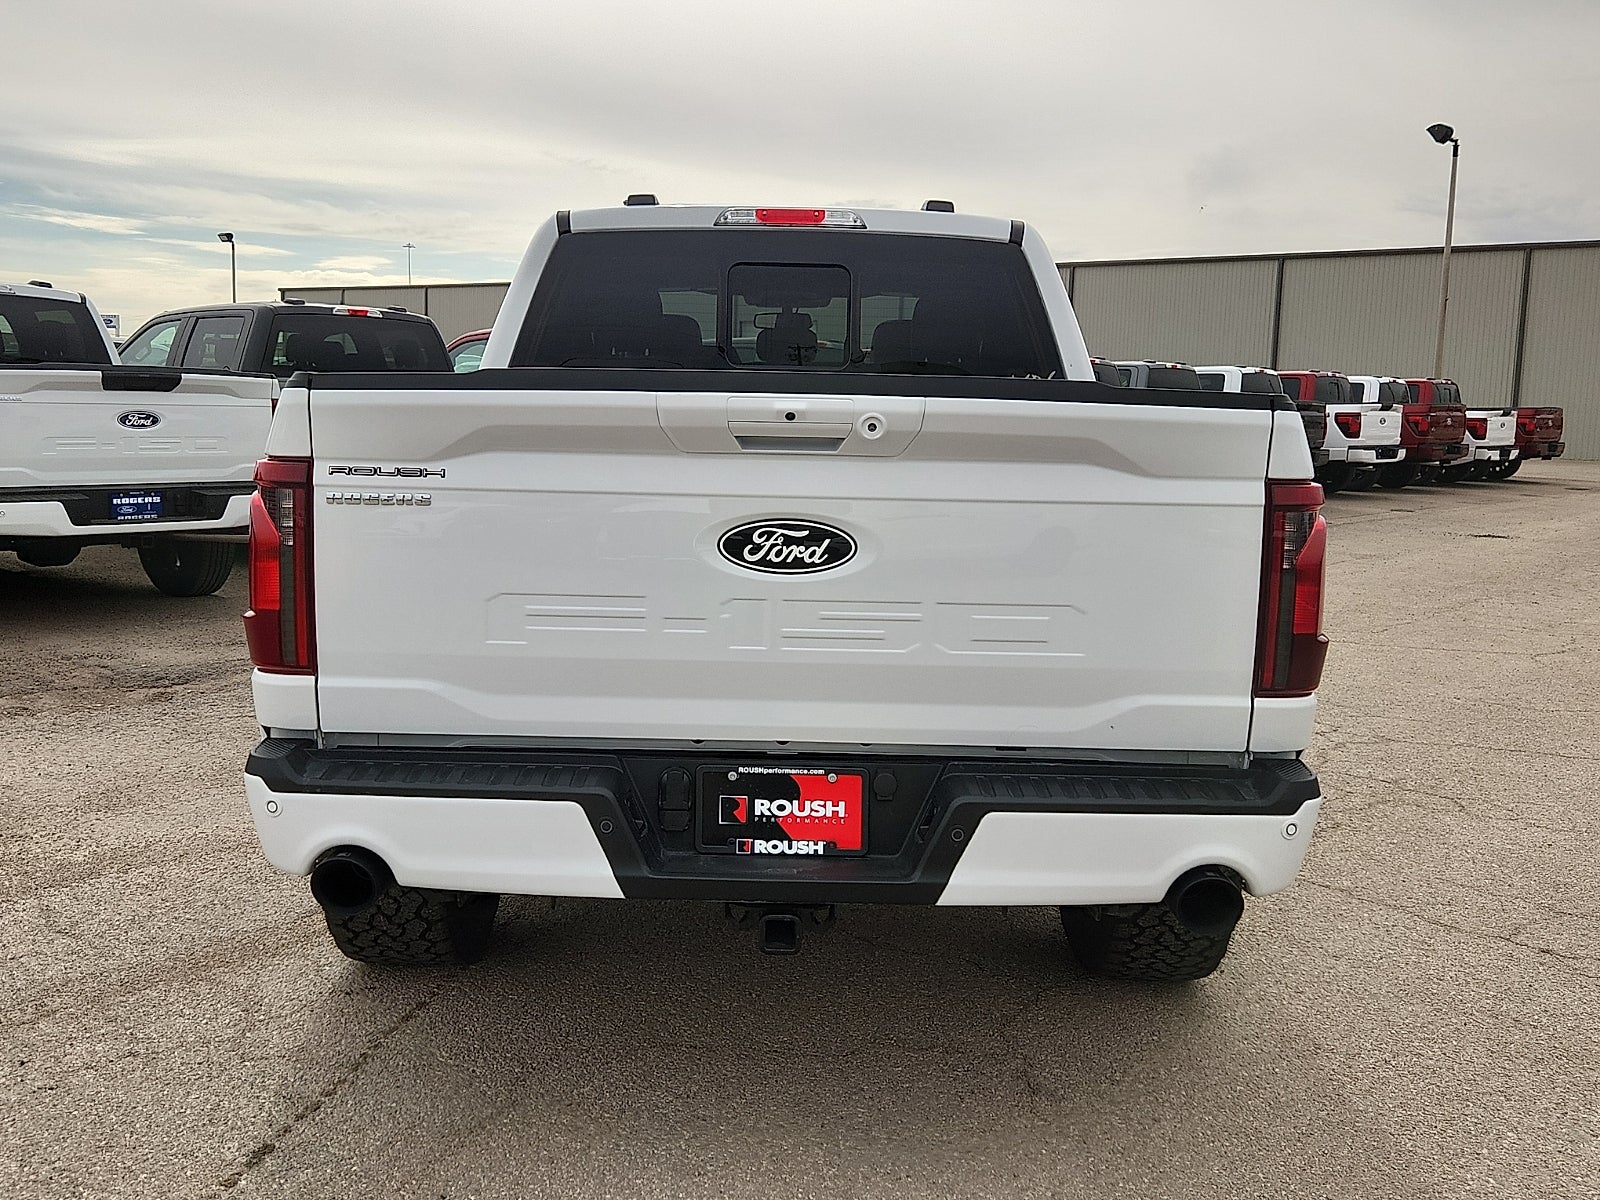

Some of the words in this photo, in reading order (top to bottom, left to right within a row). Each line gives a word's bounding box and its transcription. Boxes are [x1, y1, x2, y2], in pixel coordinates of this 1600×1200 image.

[328, 465, 446, 478] ROUSH
[112, 496, 161, 505] ROGERS
[326, 491, 432, 506] ROGERS
[743, 527, 832, 563] Ford
[485, 592, 1085, 655] F-150
[738, 766, 825, 775] ROUSHperformance.com
[754, 799, 846, 818] ROUSH
[754, 839, 825, 855] ROUSH
